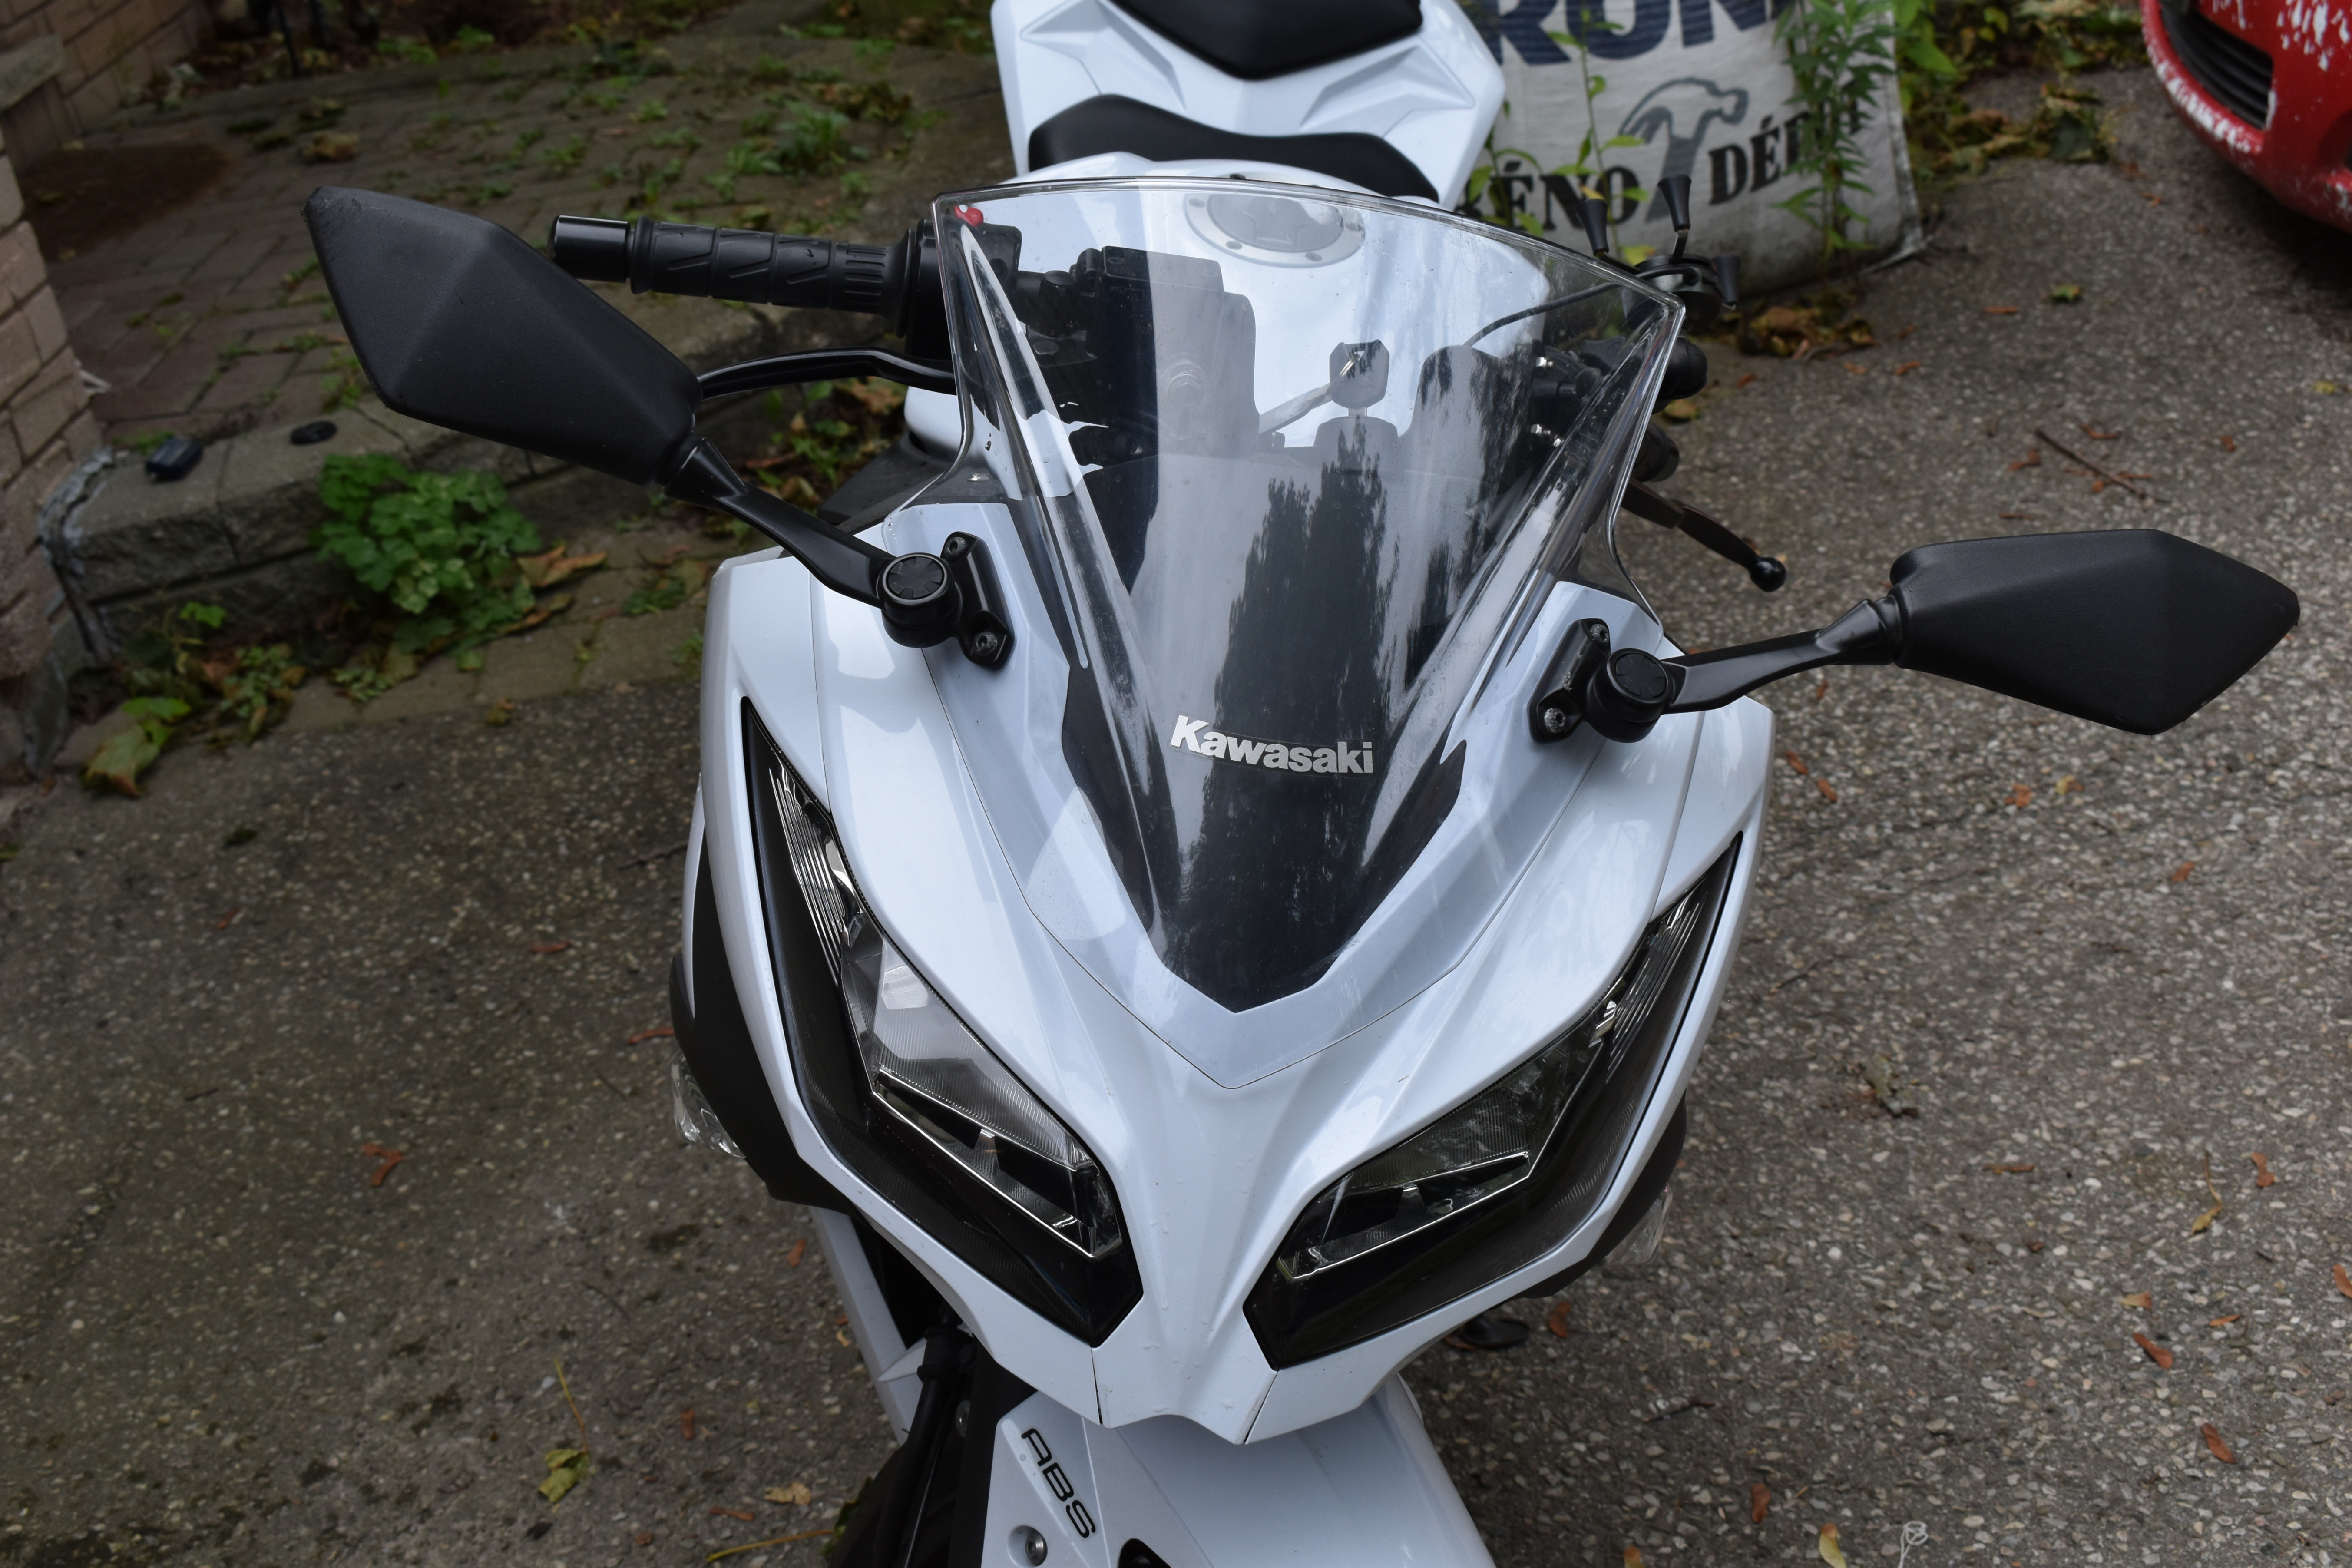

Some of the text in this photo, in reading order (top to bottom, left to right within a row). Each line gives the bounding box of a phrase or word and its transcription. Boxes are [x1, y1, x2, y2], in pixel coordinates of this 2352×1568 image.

[1459, 0, 1795, 66] RON
[1170, 715, 1374, 774] Kawasaki
[1021, 1428, 1096, 1538] ABS
